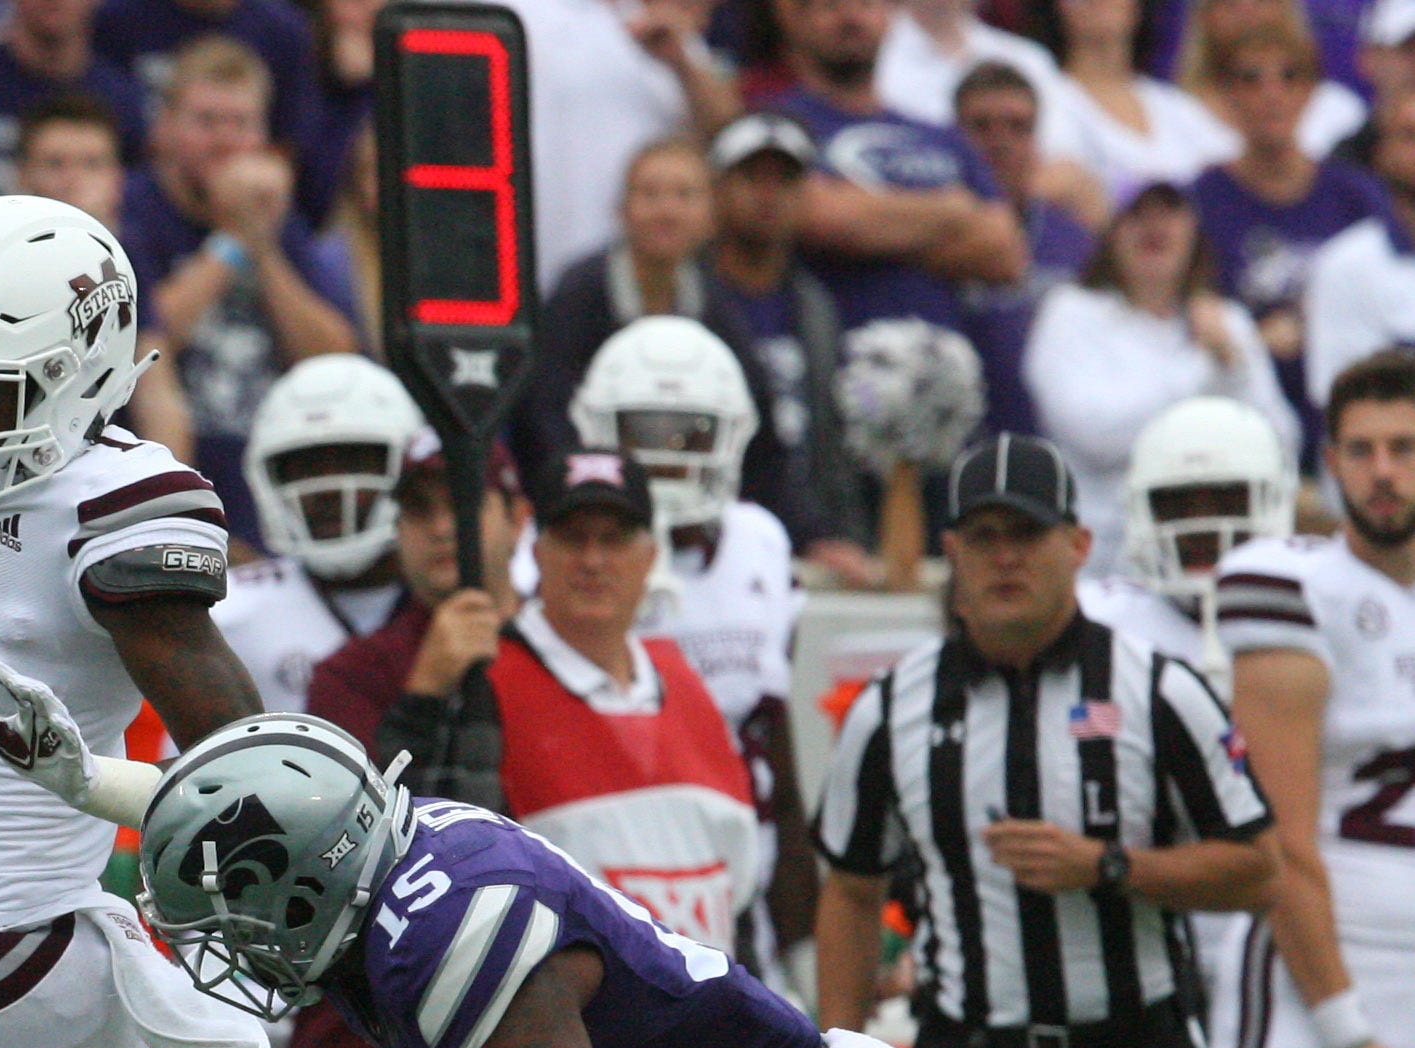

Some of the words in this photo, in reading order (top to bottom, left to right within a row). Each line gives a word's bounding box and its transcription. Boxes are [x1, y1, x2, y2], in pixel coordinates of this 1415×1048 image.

[401, 28, 519, 326] 3
[83, 283, 126, 320] STATE
[163, 548, 224, 579] GEAR
[357, 804, 375, 833] 15
[1085, 780, 1117, 826] L
[376, 853, 452, 949] 15
